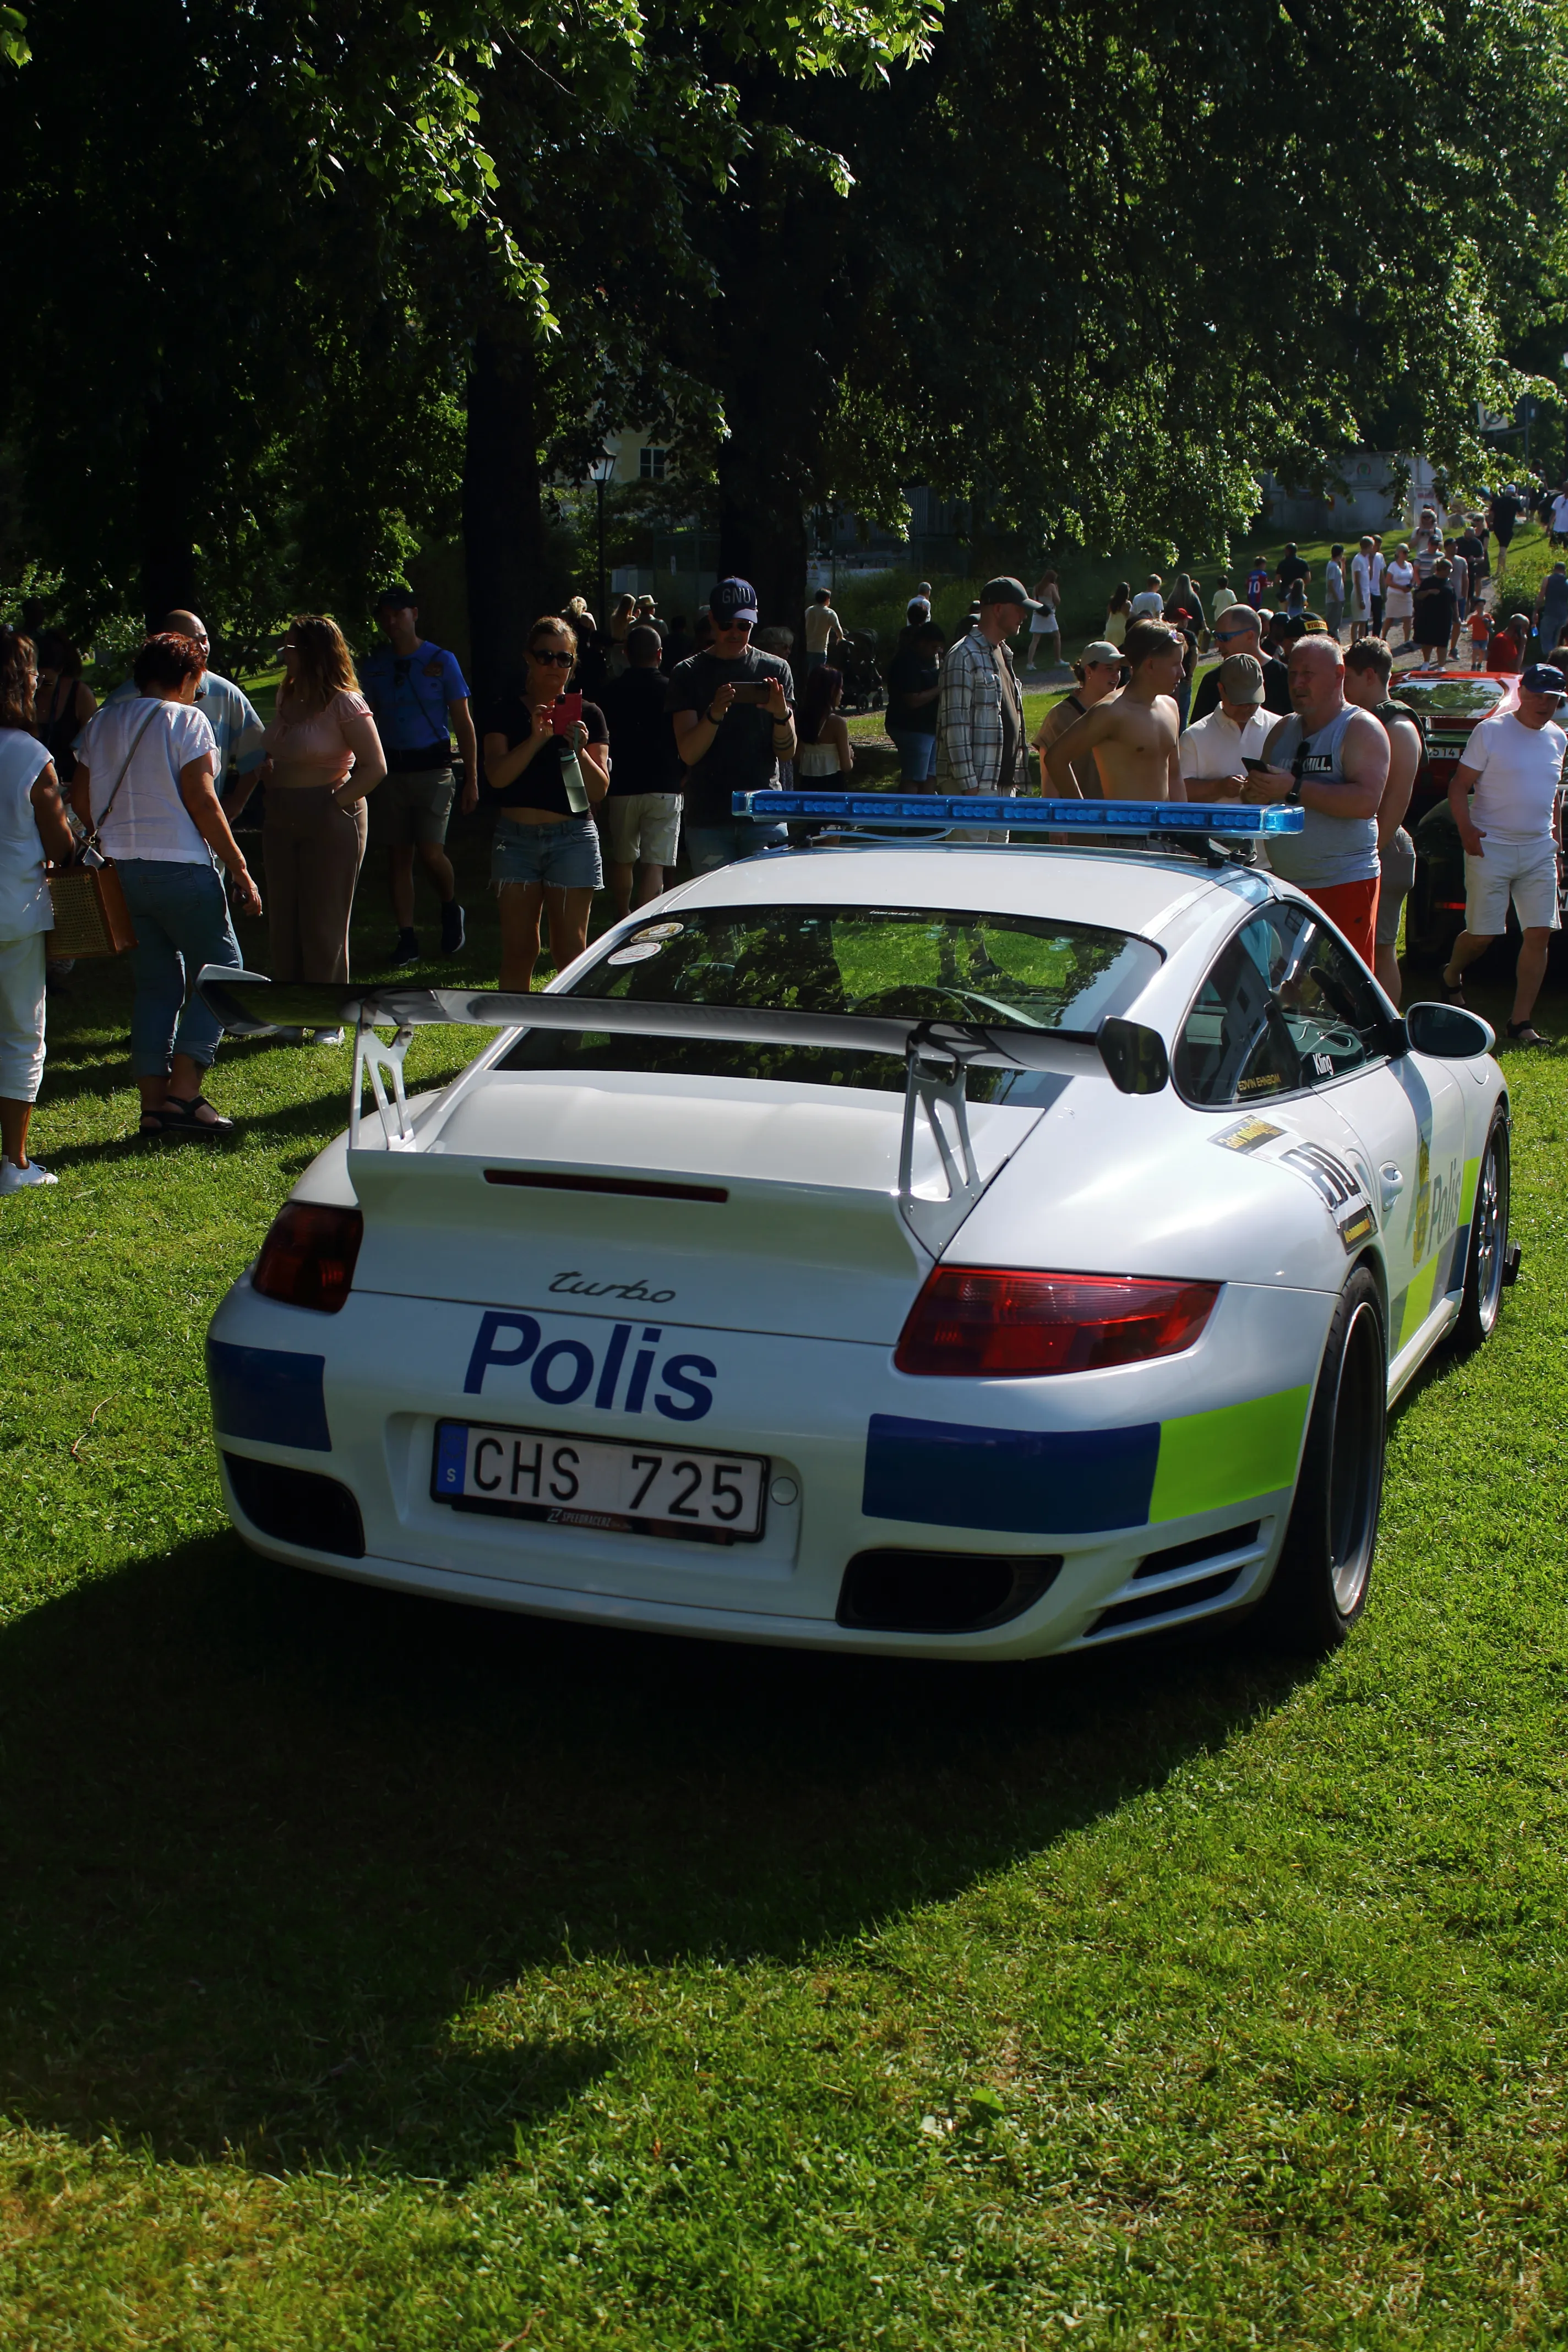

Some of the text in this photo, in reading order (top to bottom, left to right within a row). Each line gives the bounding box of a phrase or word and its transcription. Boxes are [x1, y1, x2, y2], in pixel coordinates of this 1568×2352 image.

[722, 586, 750, 605] GNU
[1248, 581, 1260, 594] 10
[1313, 1053, 1334, 1076] Kling
[1238, 1077, 1256, 1091] EDVIN
[1427, 1157, 1461, 1256] Polis
[548, 1271, 676, 1304] turbo
[462, 1310, 717, 1422] Polis
[447, 1467, 456, 1483] S
[473, 1437, 744, 1522] CHS 725
[562, 1510, 611, 1528] SPEEDRACERZ
